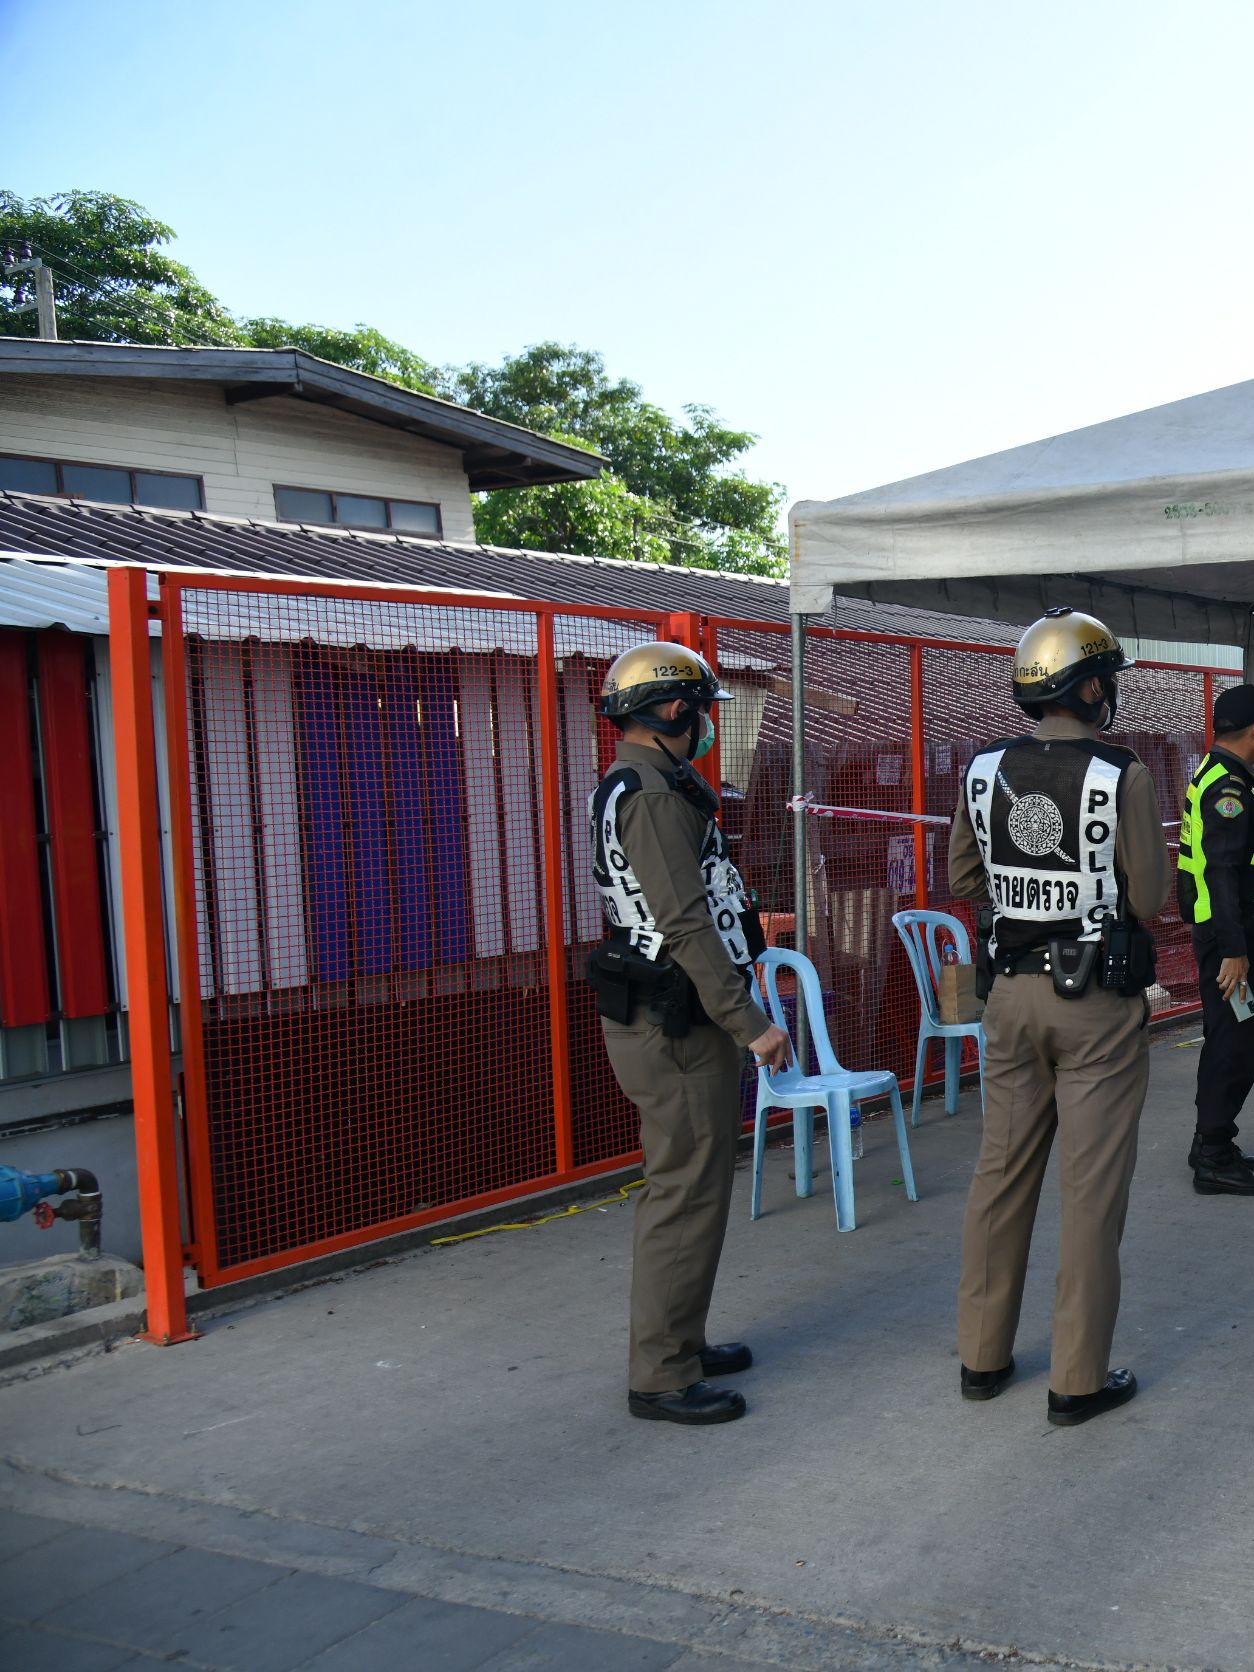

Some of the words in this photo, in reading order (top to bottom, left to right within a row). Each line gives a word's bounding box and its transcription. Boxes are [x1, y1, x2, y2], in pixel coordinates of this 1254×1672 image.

[1080, 638, 1109, 657] 121-3
[652, 665, 694, 678] 122-3
[1085, 788, 1109, 935] POLIC
[604, 819, 654, 957] POLIE
[993, 873, 1079, 912] สายตรวจ
